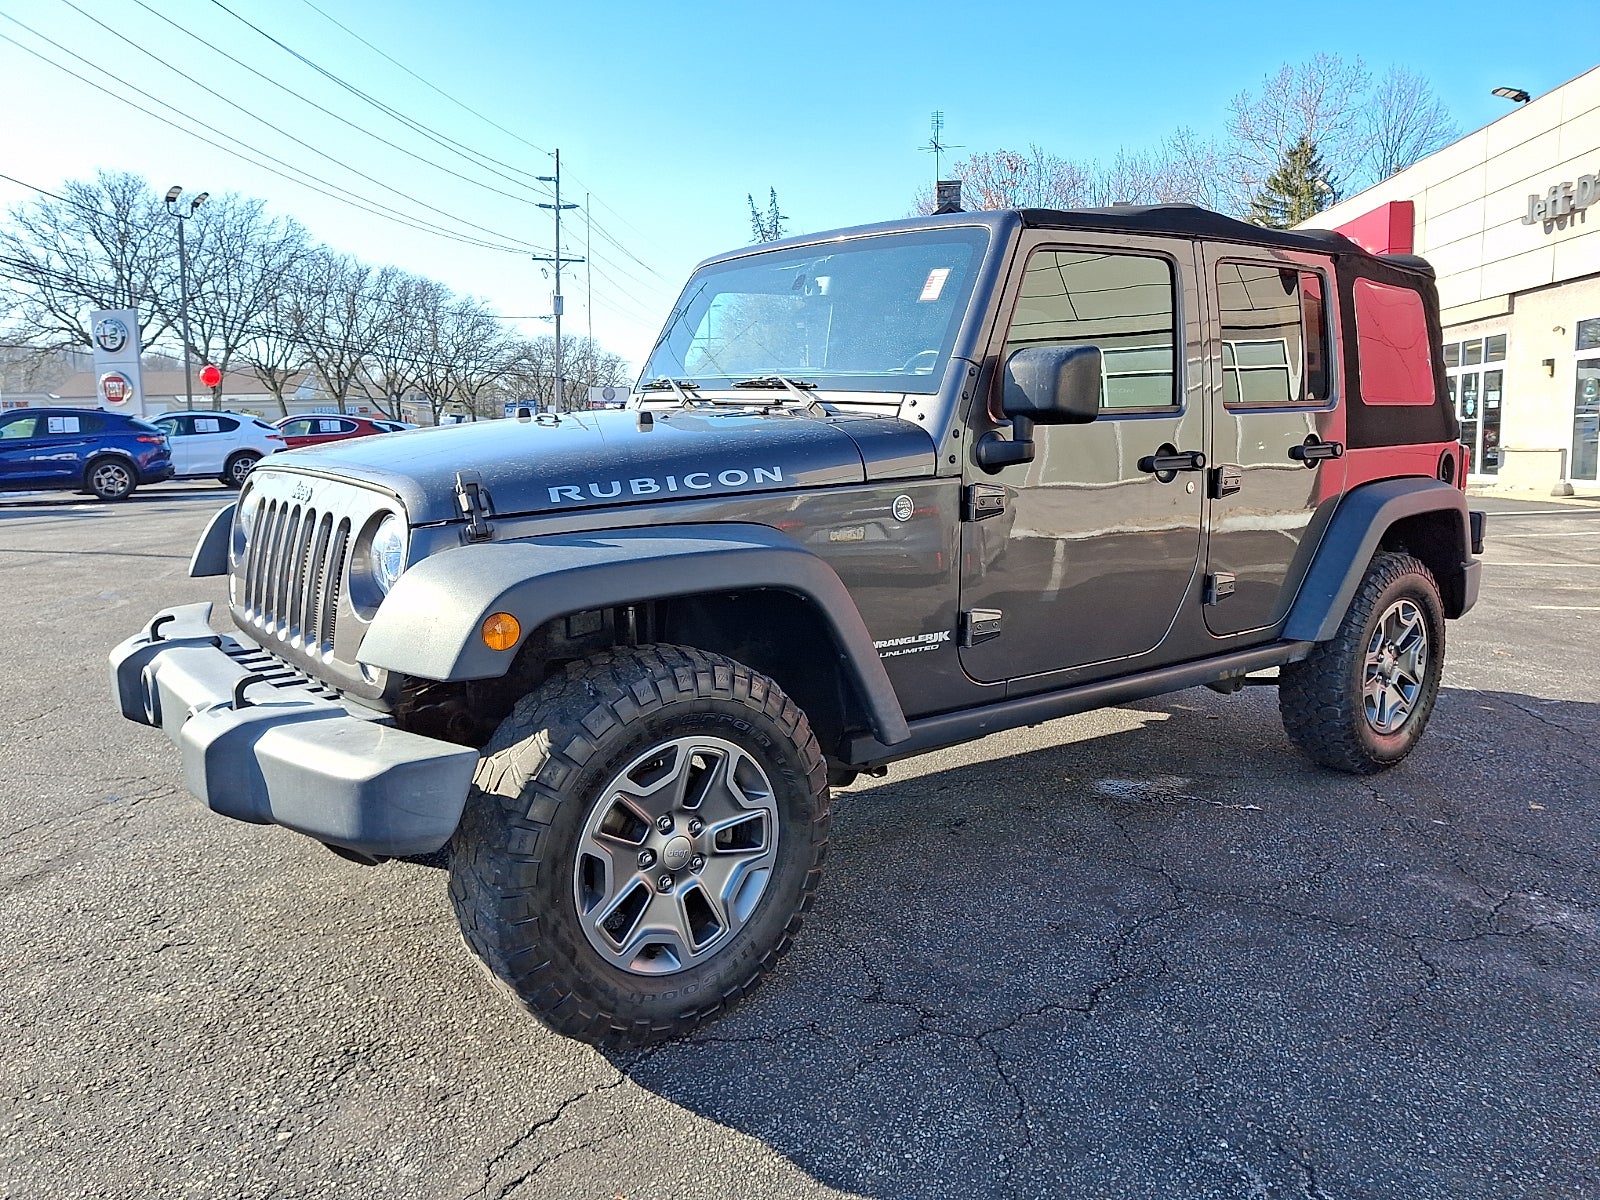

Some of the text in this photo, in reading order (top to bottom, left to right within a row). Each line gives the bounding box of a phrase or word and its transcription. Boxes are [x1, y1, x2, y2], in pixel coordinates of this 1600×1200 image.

[1522, 182, 1573, 225] Jeff
[547, 466, 784, 504] RUBICON
[879, 644, 940, 658] UNLIMITED
